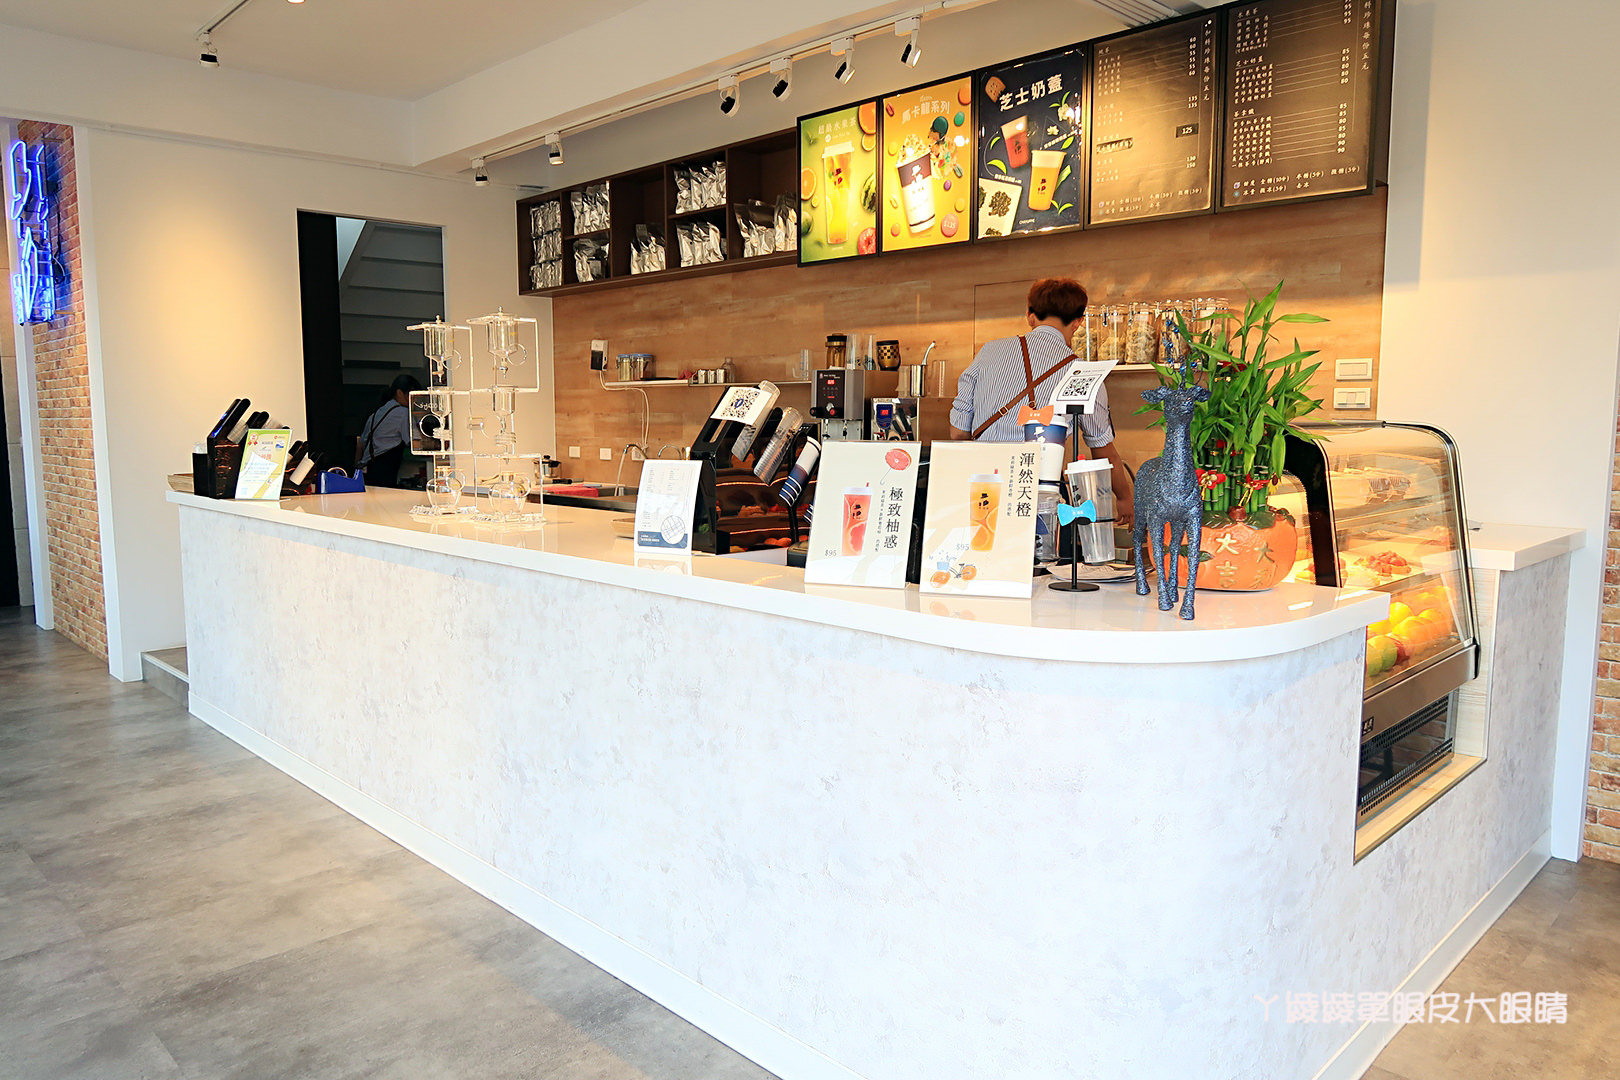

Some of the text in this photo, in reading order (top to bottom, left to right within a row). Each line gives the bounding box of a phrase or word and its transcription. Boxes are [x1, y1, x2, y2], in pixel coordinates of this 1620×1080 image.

[1000, 74, 1063, 112] 芝士奶蓋
[1016, 452, 1035, 517] 渾然天橙
[884, 486, 904, 549] 極致柚惑
[1216, 533, 1239, 588] 大吉
